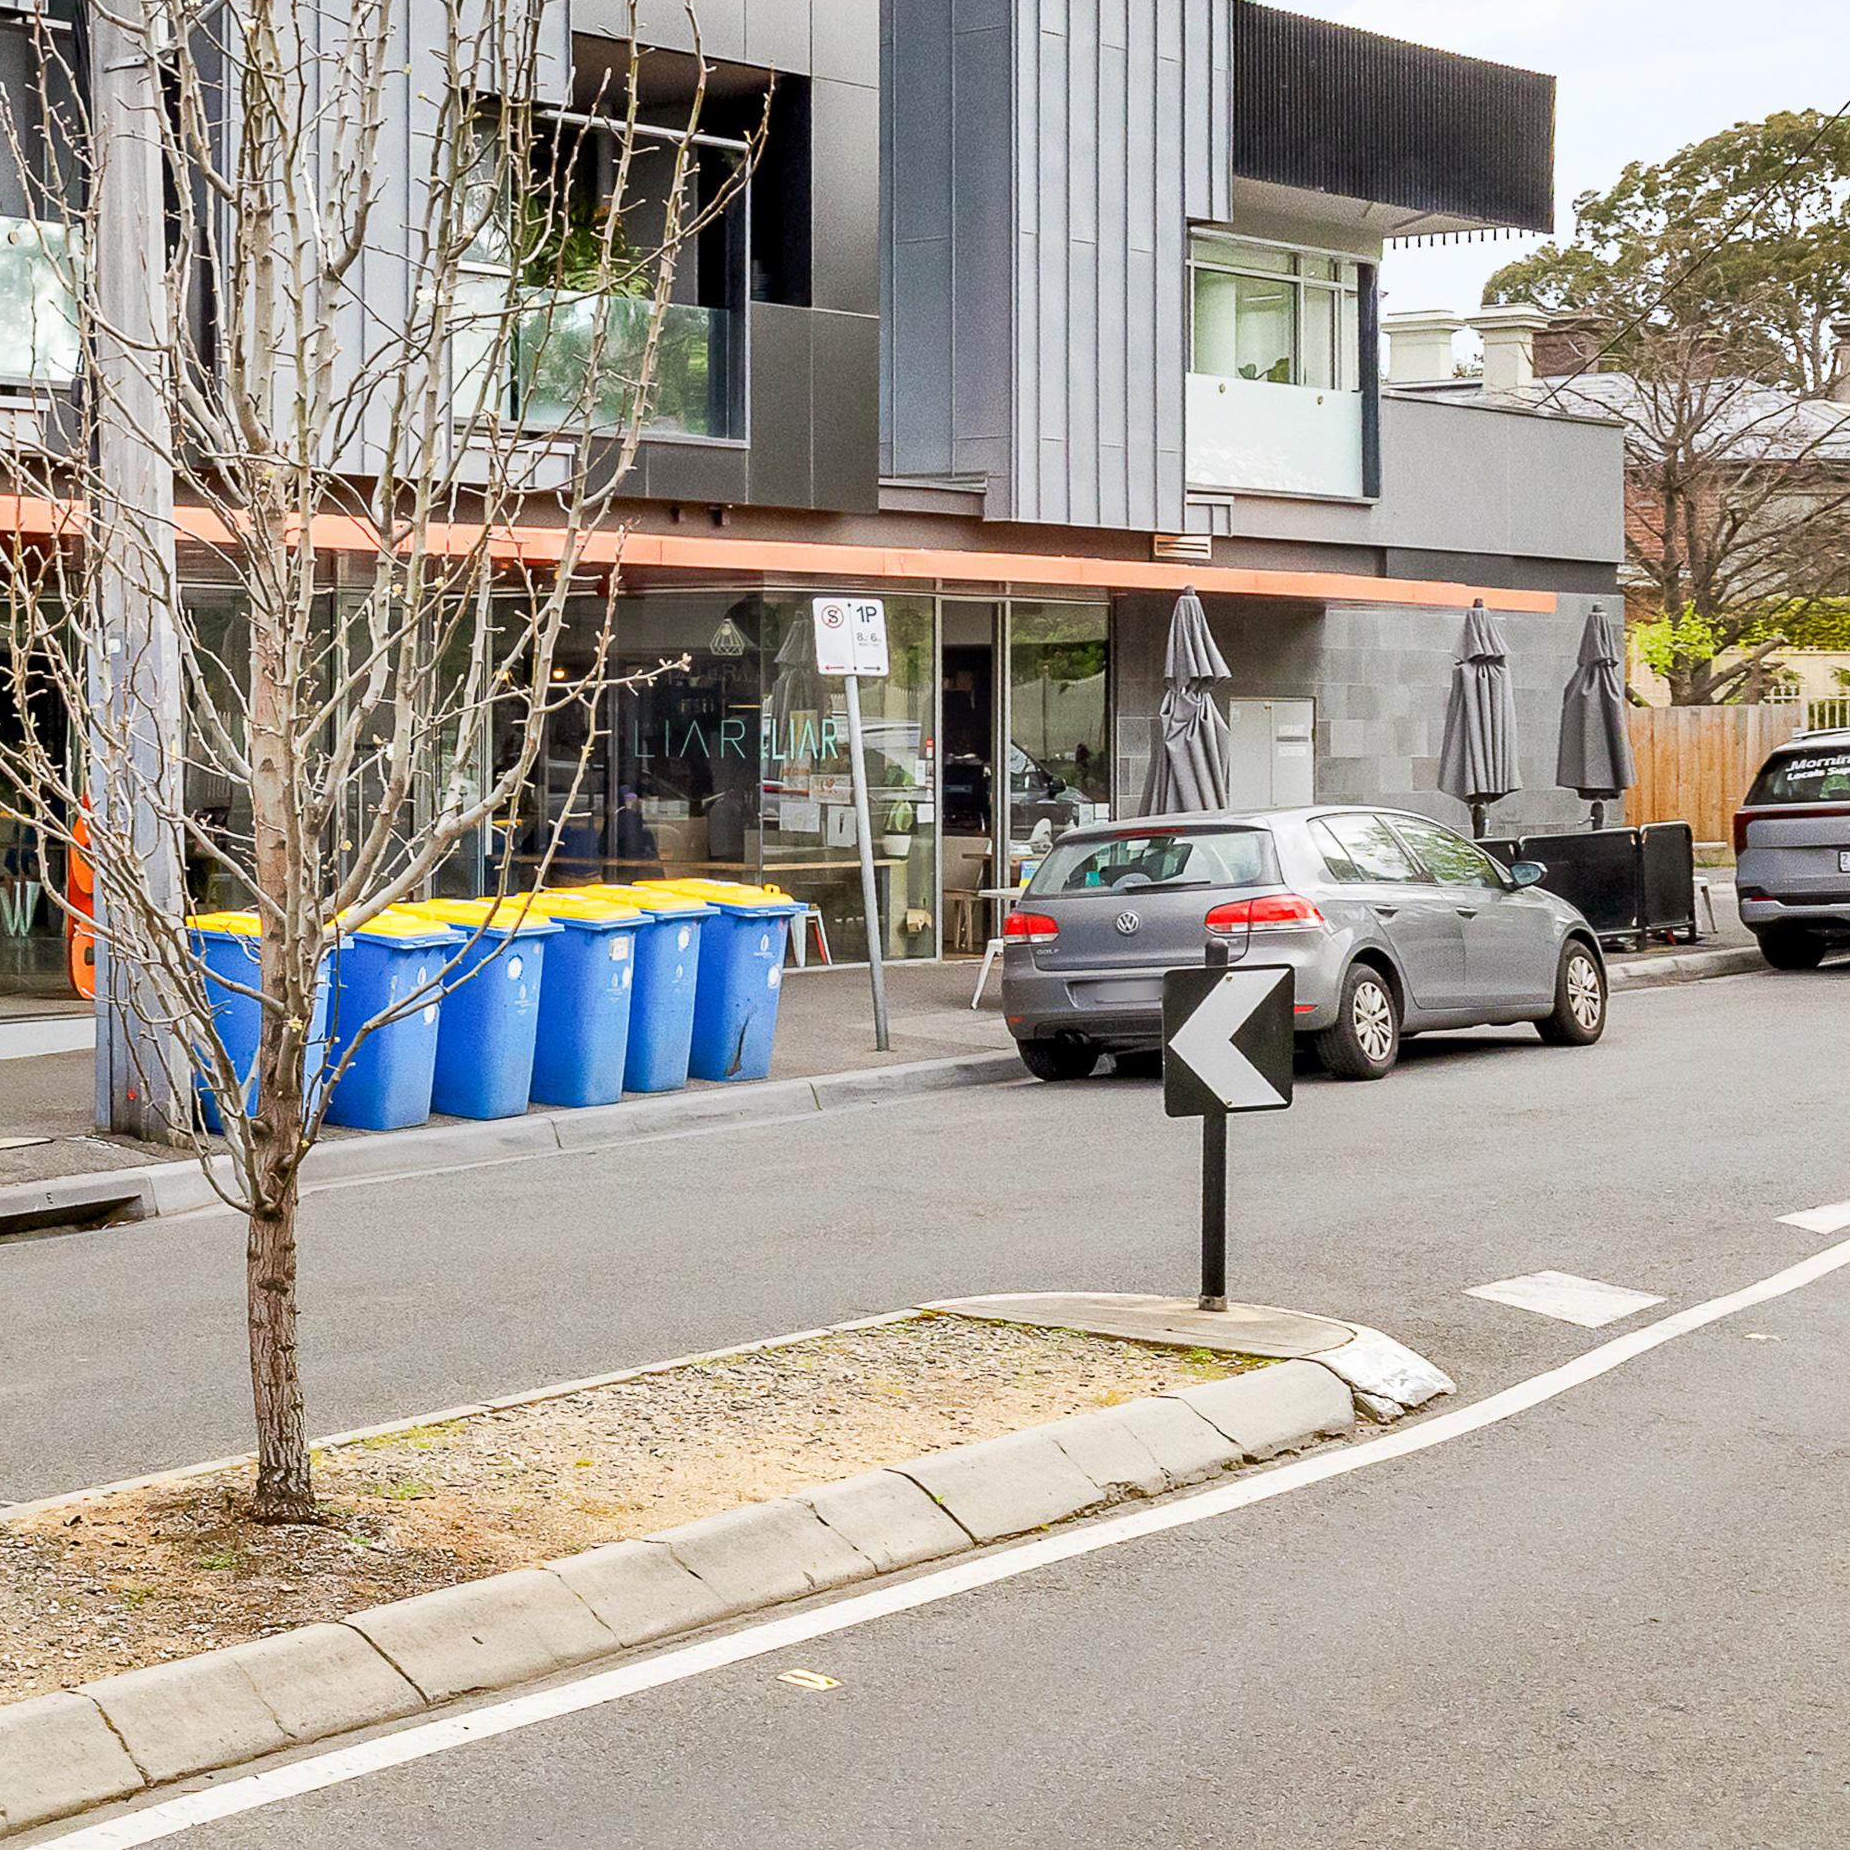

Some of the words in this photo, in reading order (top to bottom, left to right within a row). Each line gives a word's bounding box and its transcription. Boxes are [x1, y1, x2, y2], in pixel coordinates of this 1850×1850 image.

[856, 606, 877, 622] 1P
[634, 719, 746, 759] LIAR
[771, 718, 839, 760] LIAR
